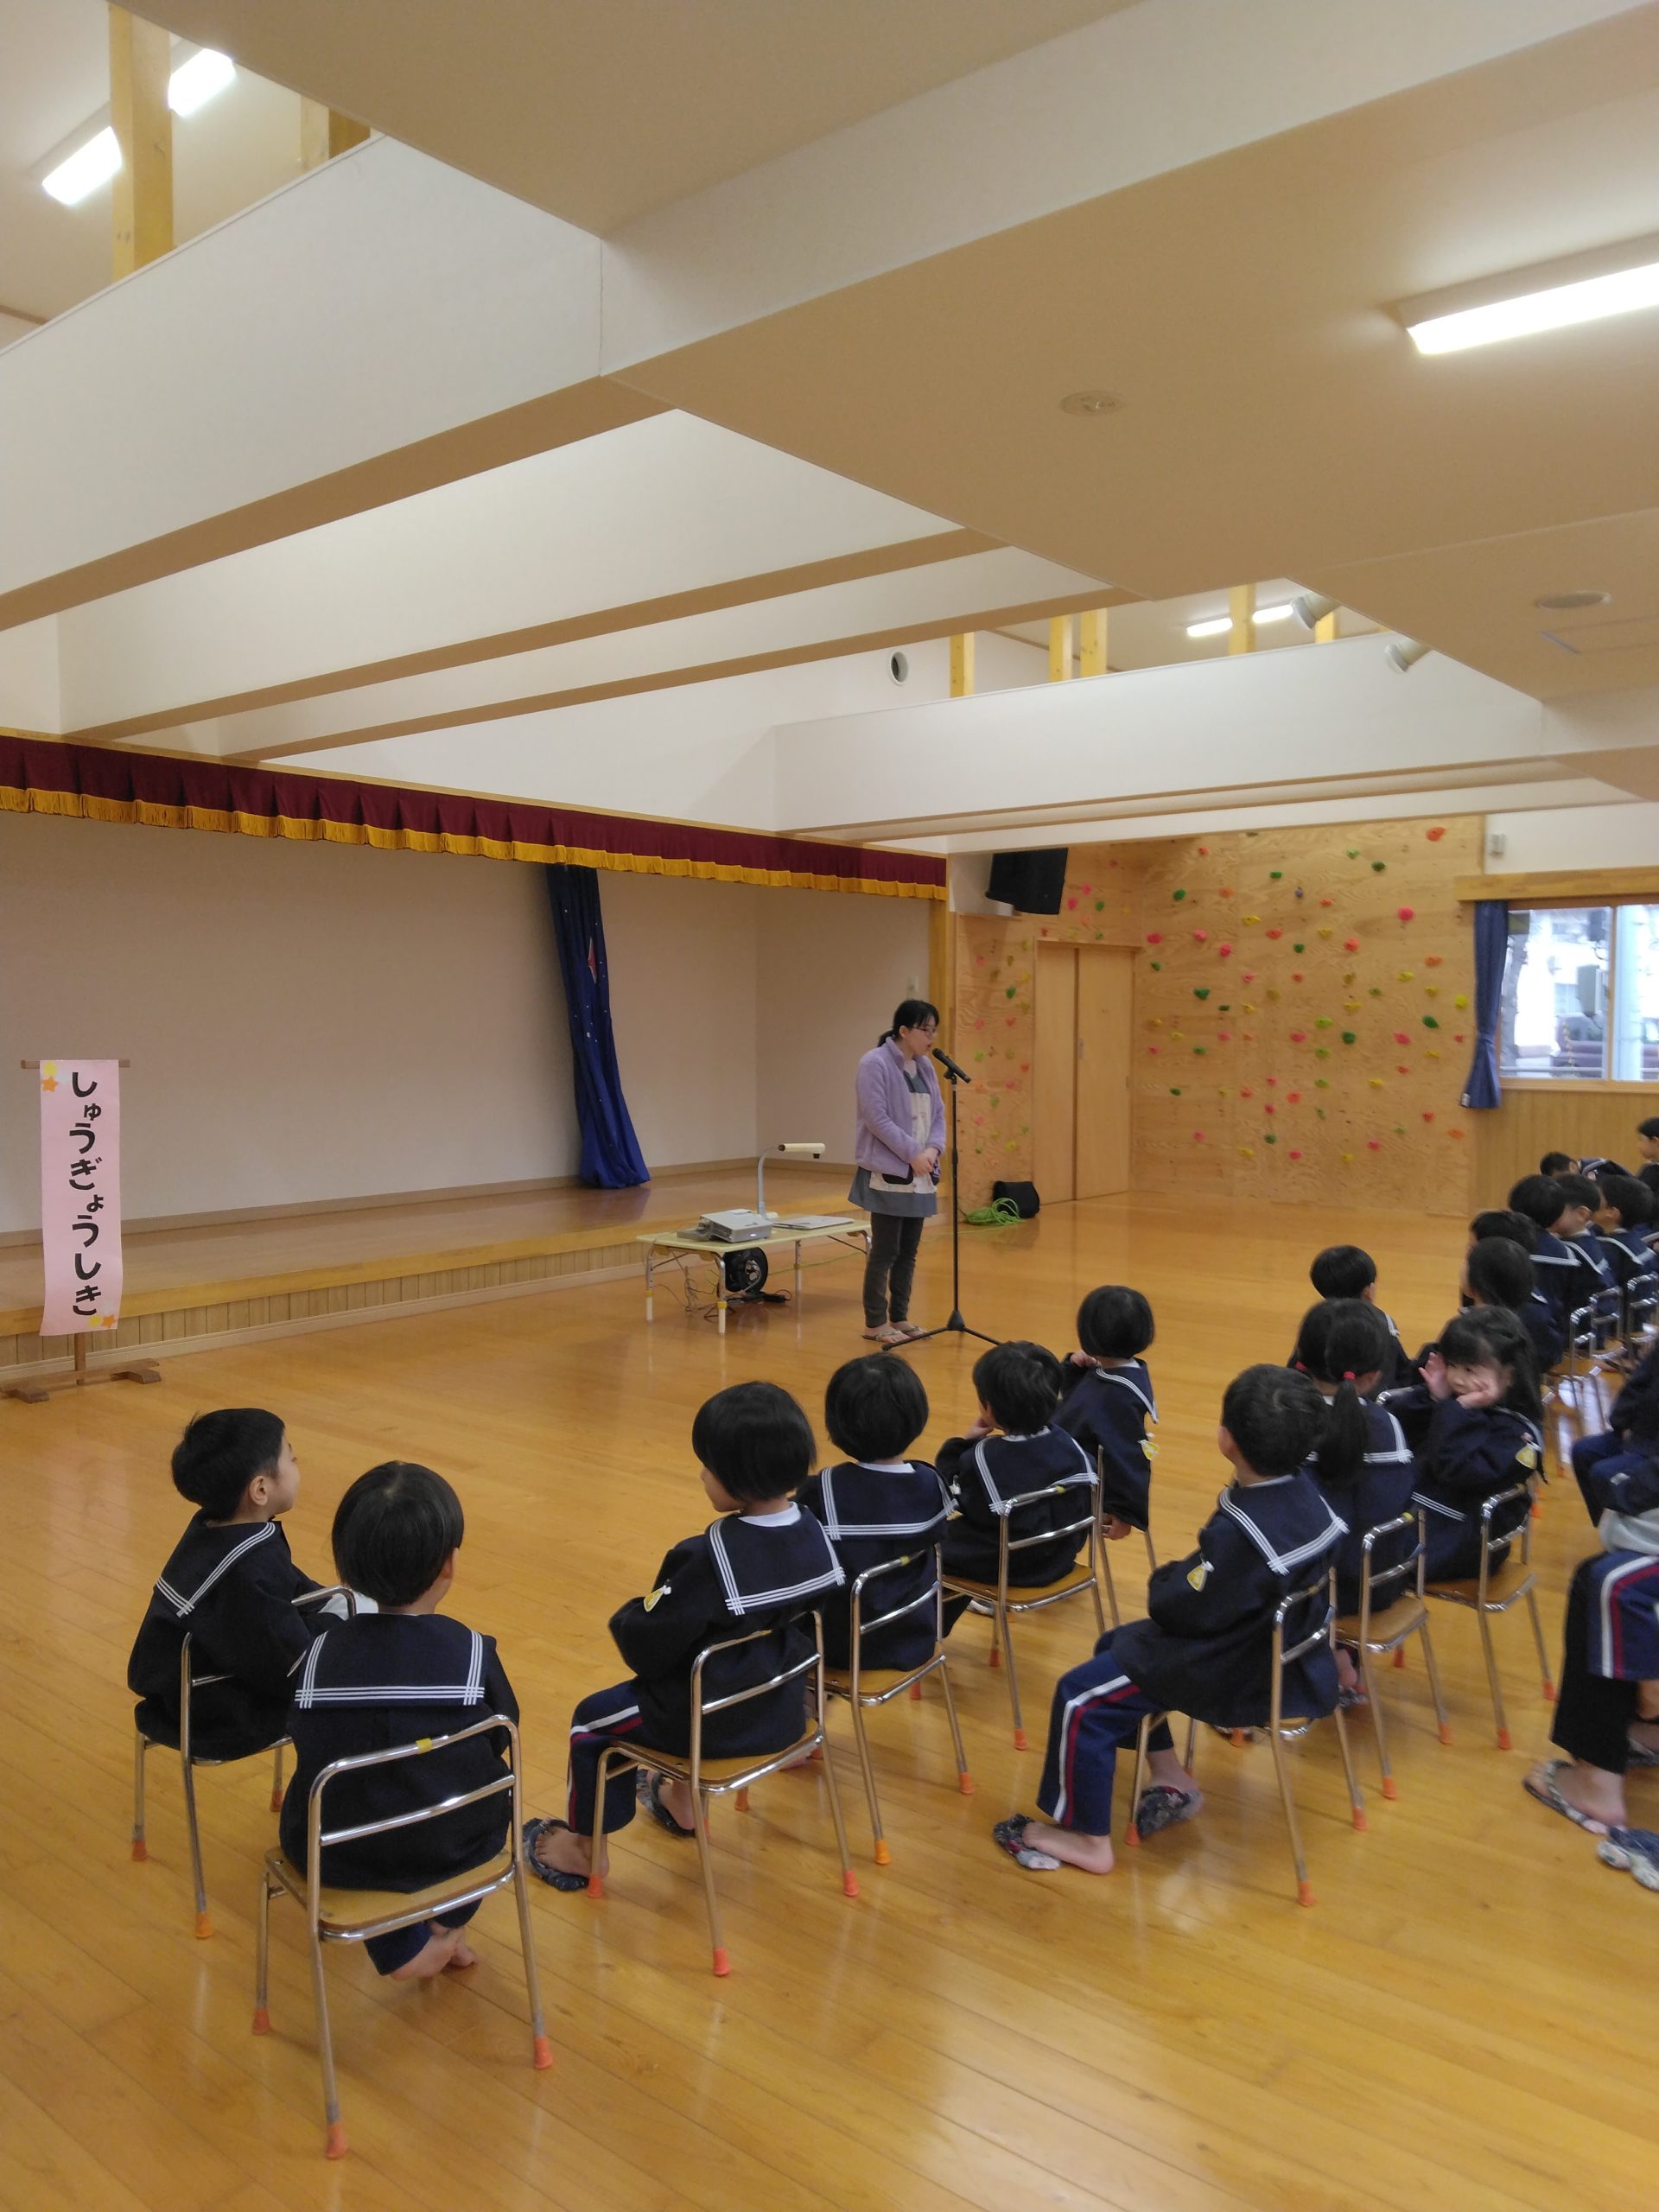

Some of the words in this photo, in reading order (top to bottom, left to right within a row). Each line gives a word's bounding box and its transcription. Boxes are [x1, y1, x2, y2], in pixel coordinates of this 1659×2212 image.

[68, 1071, 104, 1316] しゅうぎょうしき
